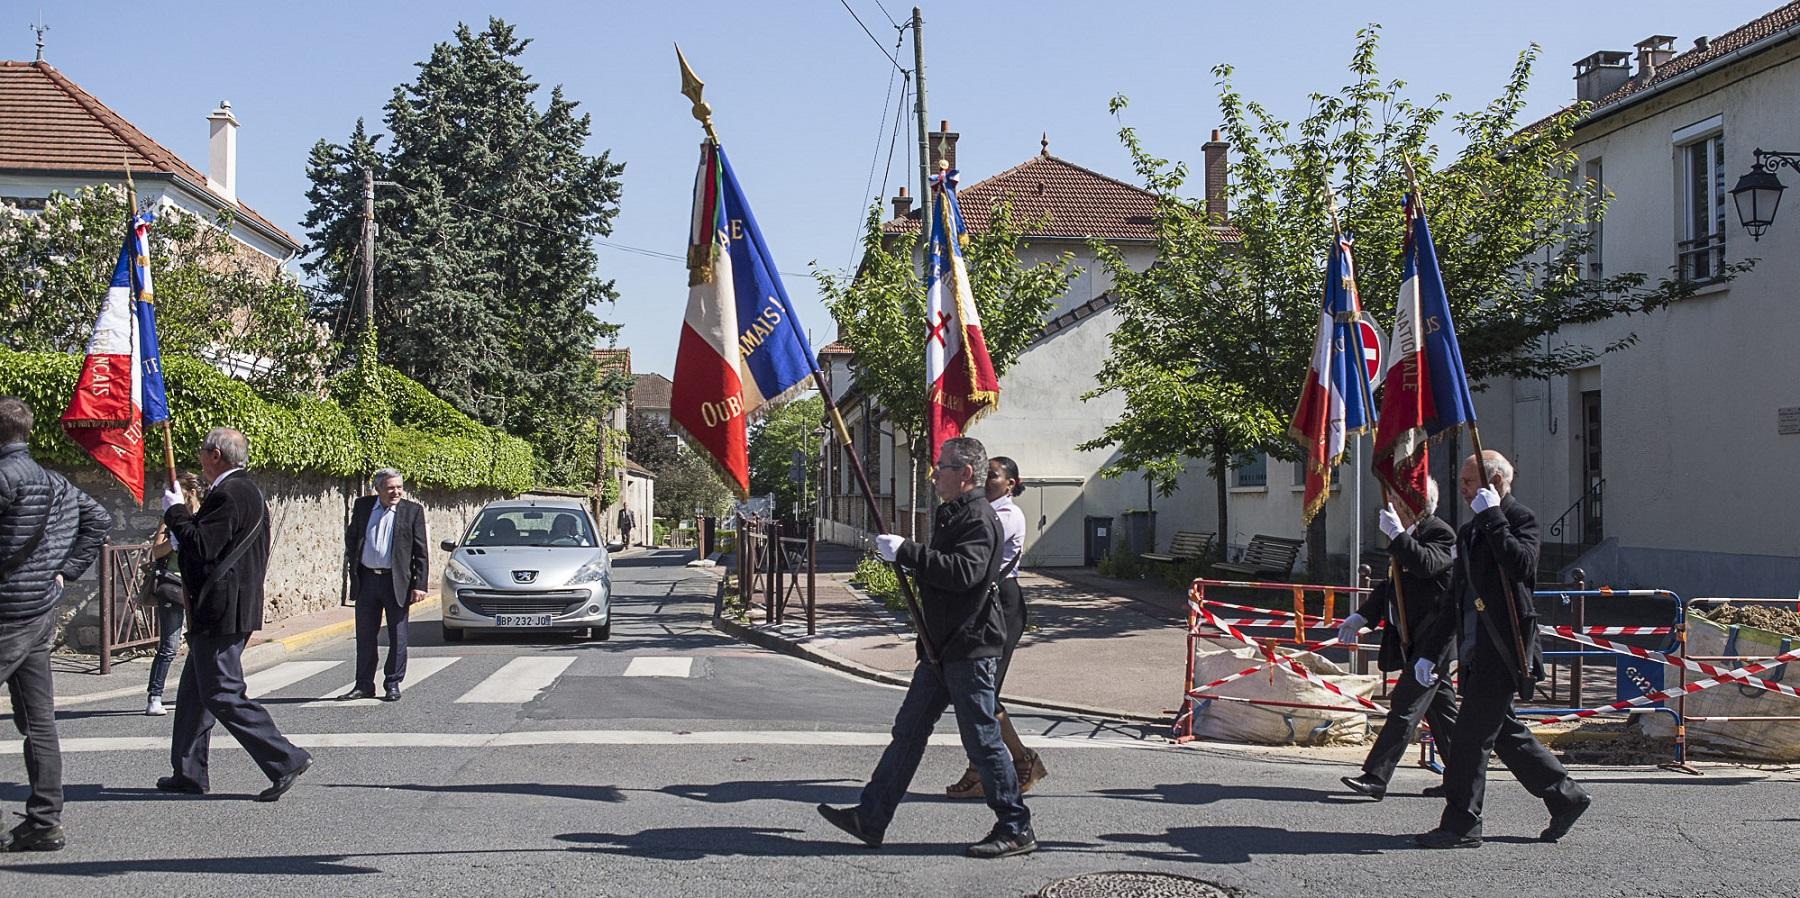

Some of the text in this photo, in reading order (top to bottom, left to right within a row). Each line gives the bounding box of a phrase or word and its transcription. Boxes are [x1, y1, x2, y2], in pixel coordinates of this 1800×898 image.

[1397, 308, 1418, 392] NATIONALE
[501, 616, 512, 626] BP
[515, 616, 532, 626] 232
